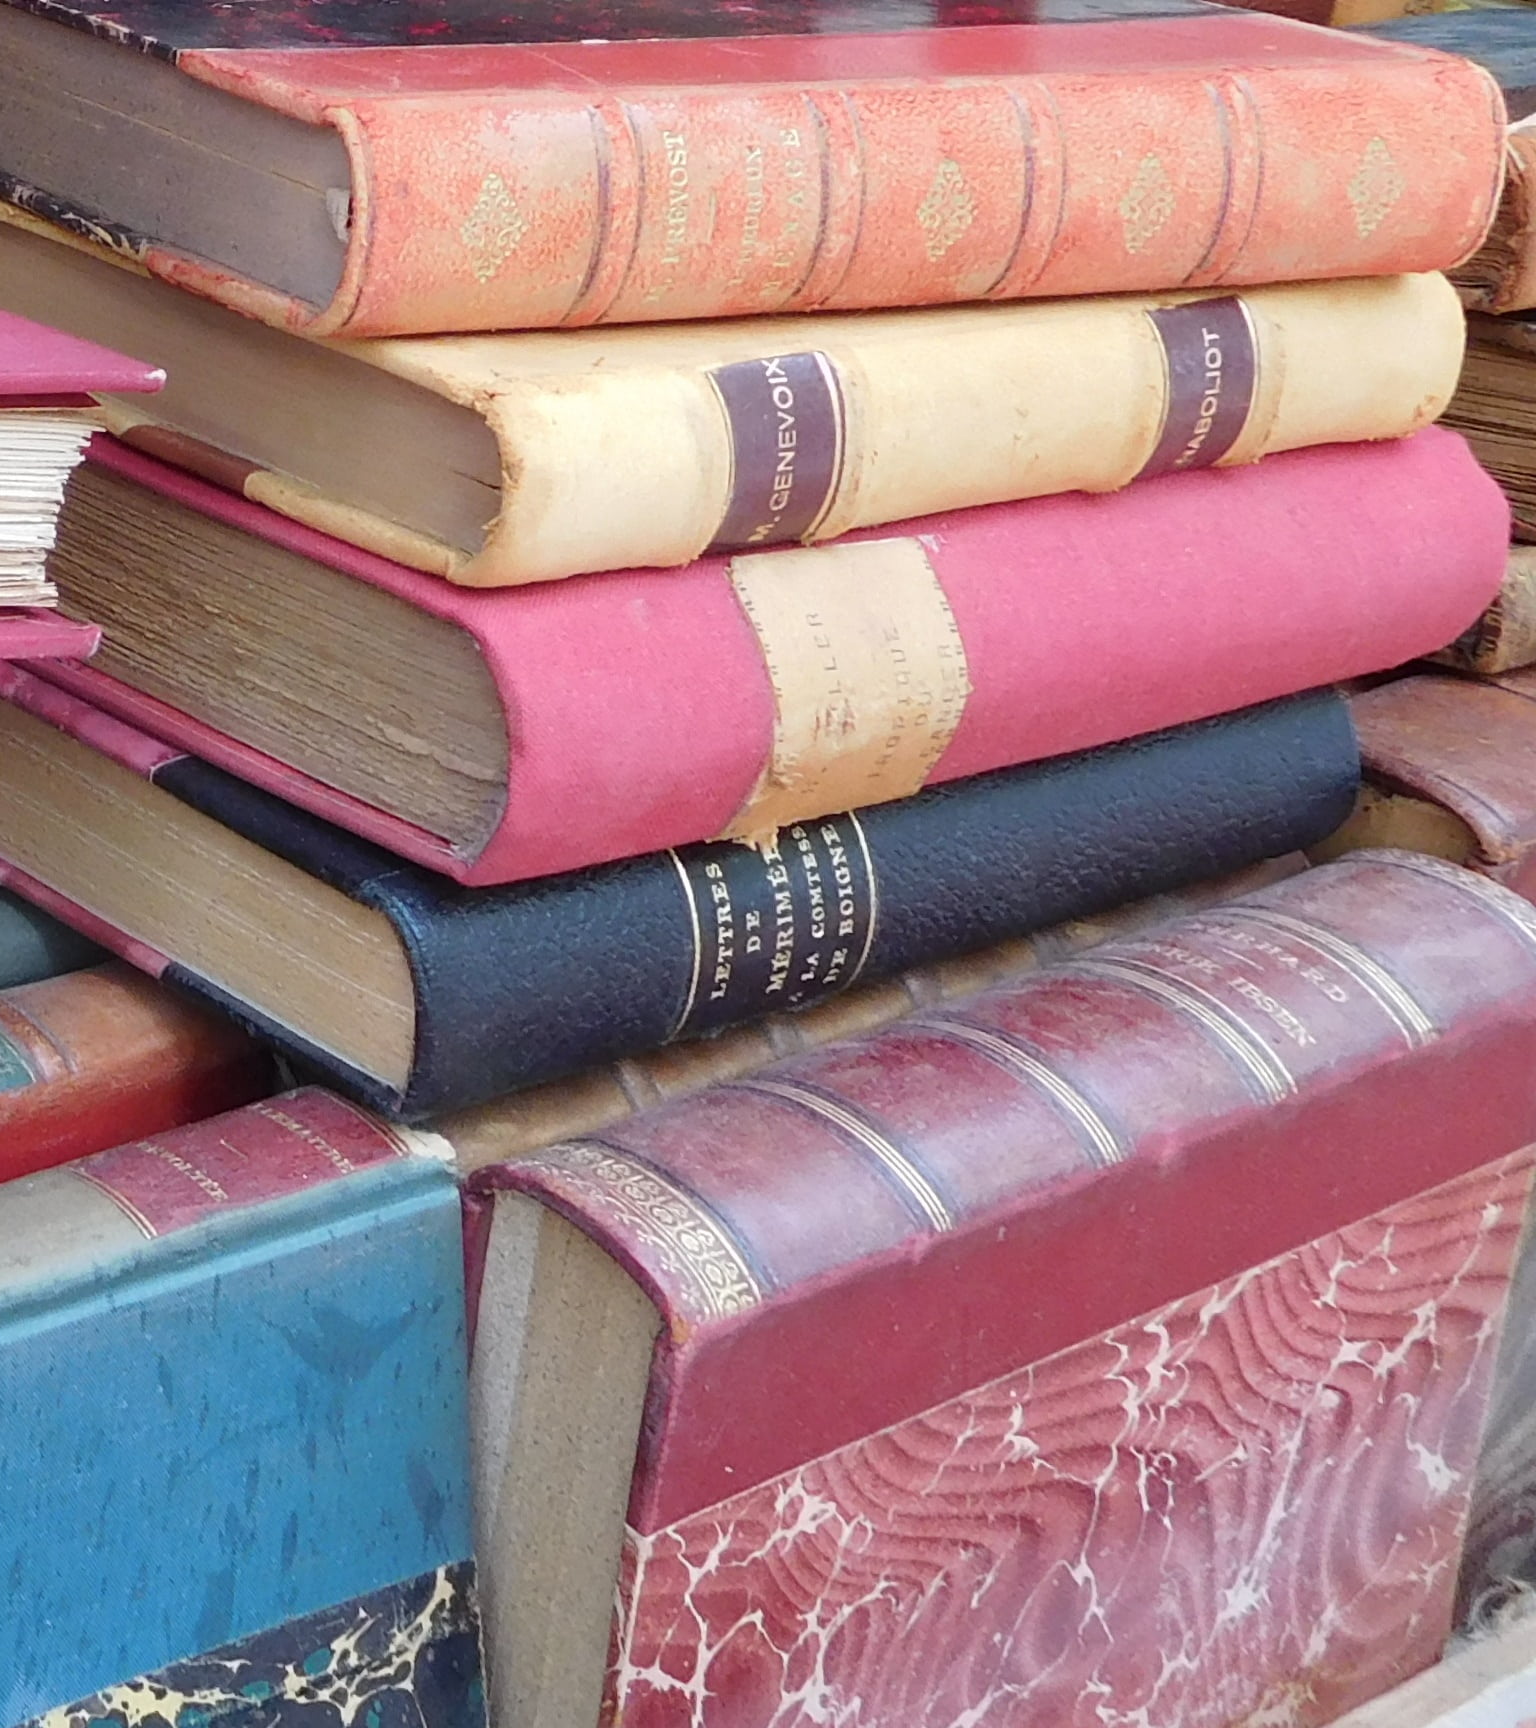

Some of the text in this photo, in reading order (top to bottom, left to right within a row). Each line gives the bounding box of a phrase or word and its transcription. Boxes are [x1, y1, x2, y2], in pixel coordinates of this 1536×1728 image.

[763, 356, 800, 514] GENEVOIX
[704, 861, 735, 1002] LETTRES
[744, 909, 763, 956] DE
[790, 823, 827, 984] LA COMTESS
[820, 823, 857, 939] BOIGNE
[1227, 975, 1319, 1049] IBSEN
